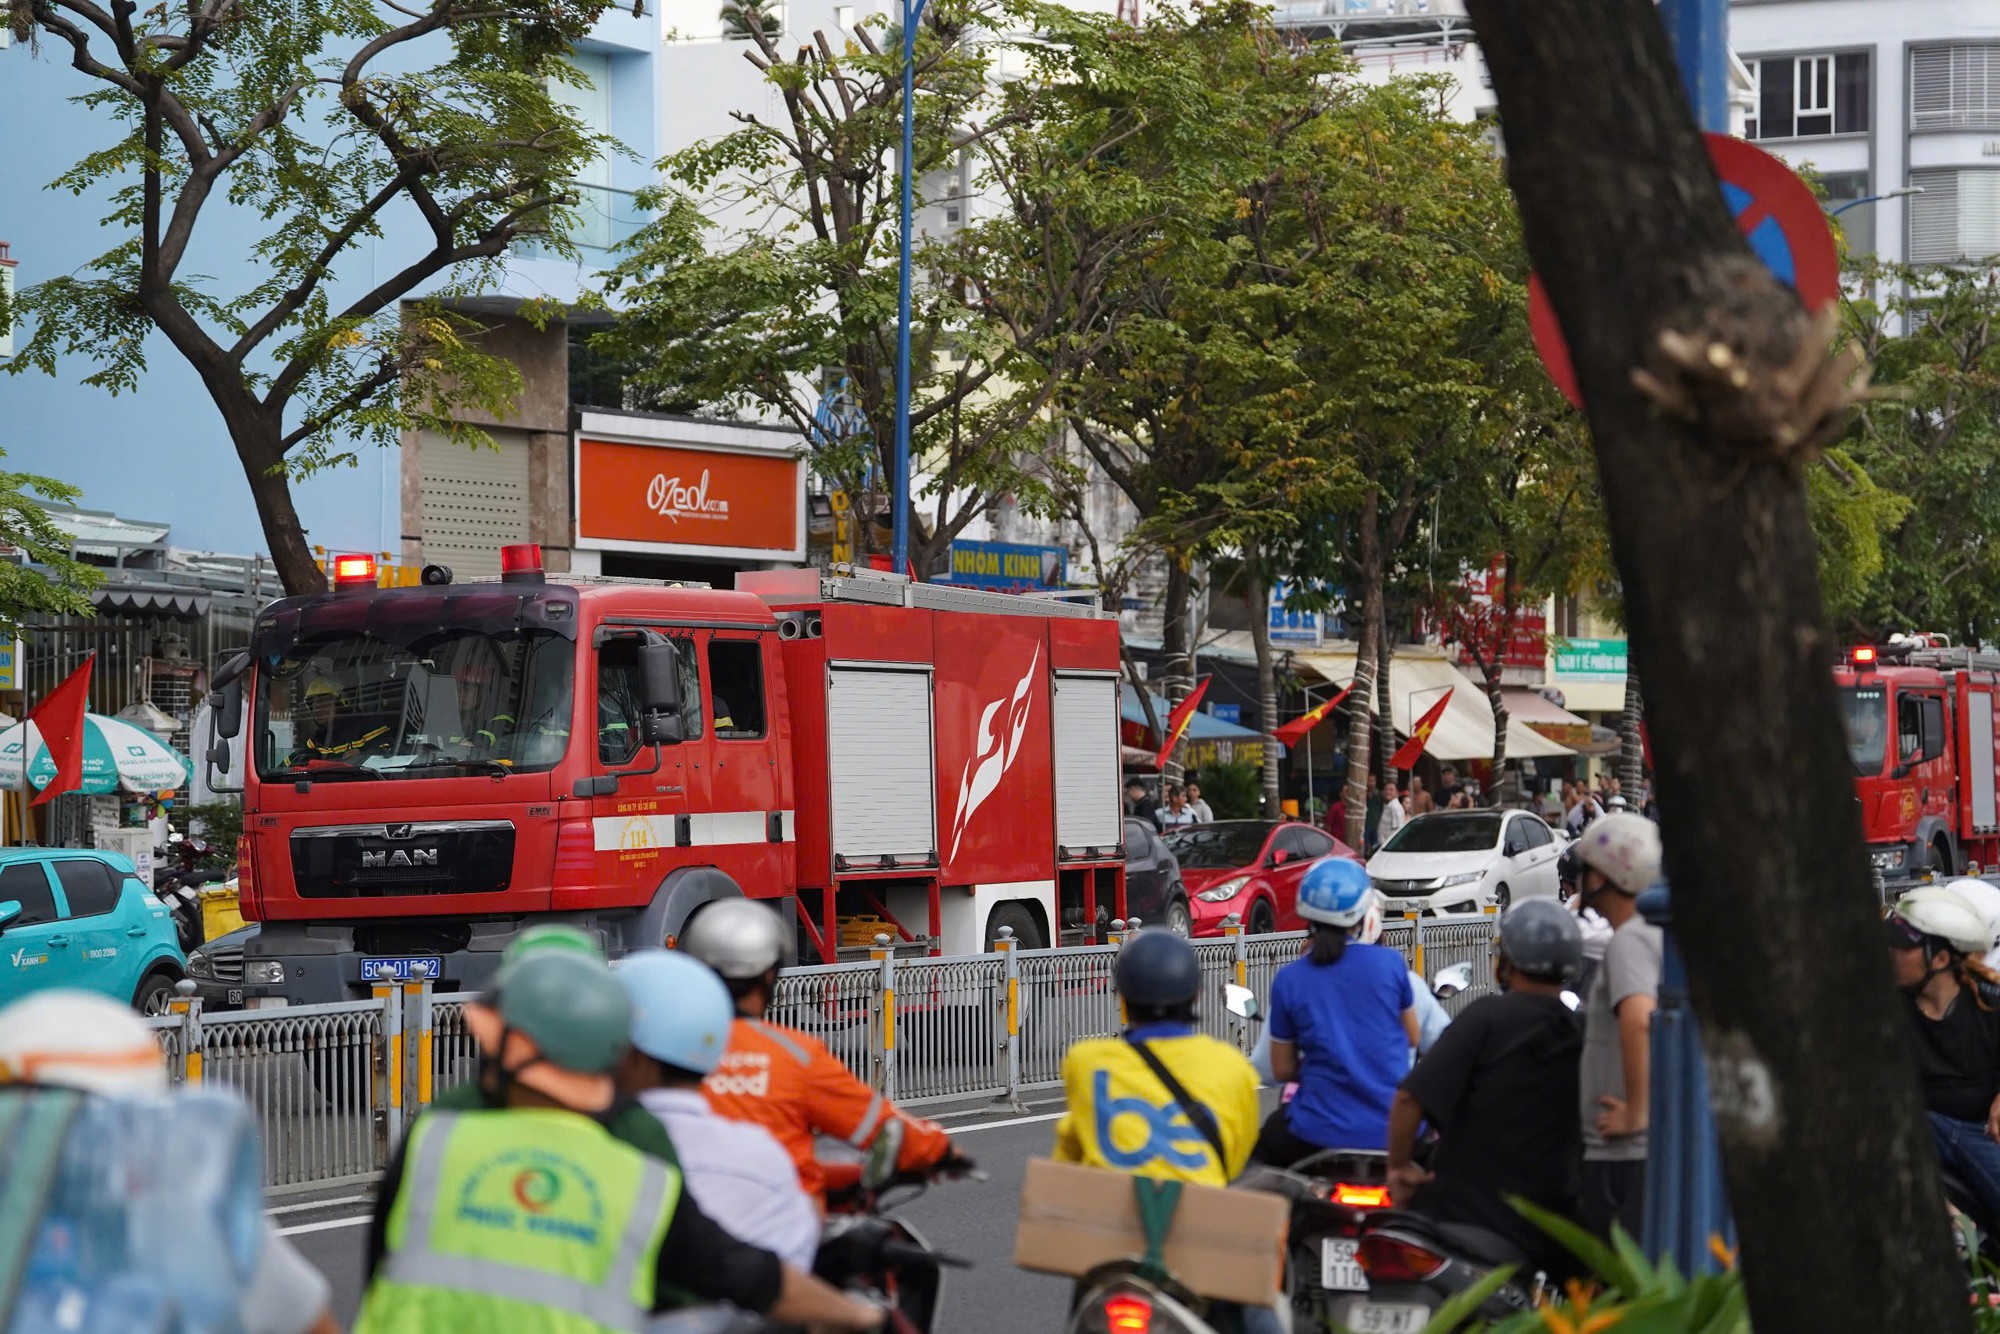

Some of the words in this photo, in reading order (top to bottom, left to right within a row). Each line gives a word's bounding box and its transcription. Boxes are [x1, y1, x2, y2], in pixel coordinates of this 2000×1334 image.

[631, 830, 648, 848] 114
[362, 848, 438, 868] MAN
[22, 956, 39, 966] XANH
